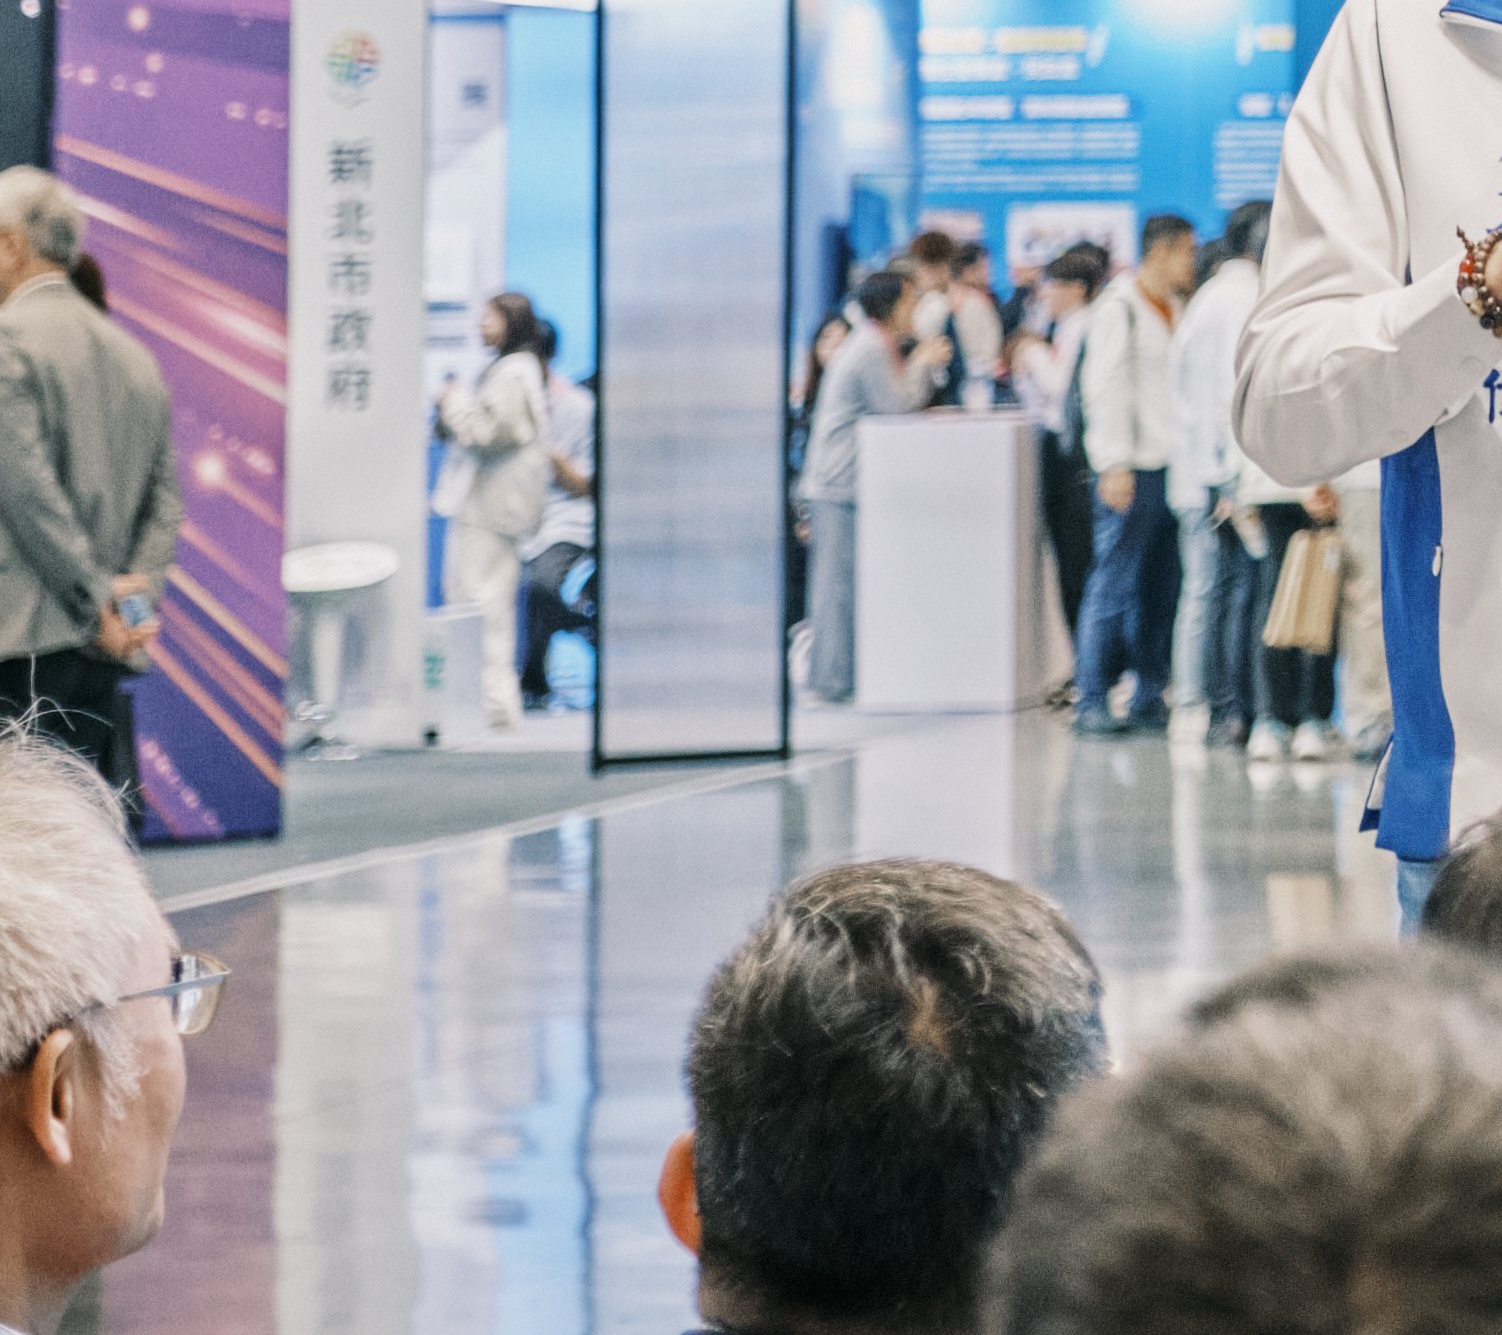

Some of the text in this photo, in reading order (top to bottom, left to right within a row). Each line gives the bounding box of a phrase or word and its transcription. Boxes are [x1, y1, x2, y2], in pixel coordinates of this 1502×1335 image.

[327, 138, 374, 412] 新北市政府
